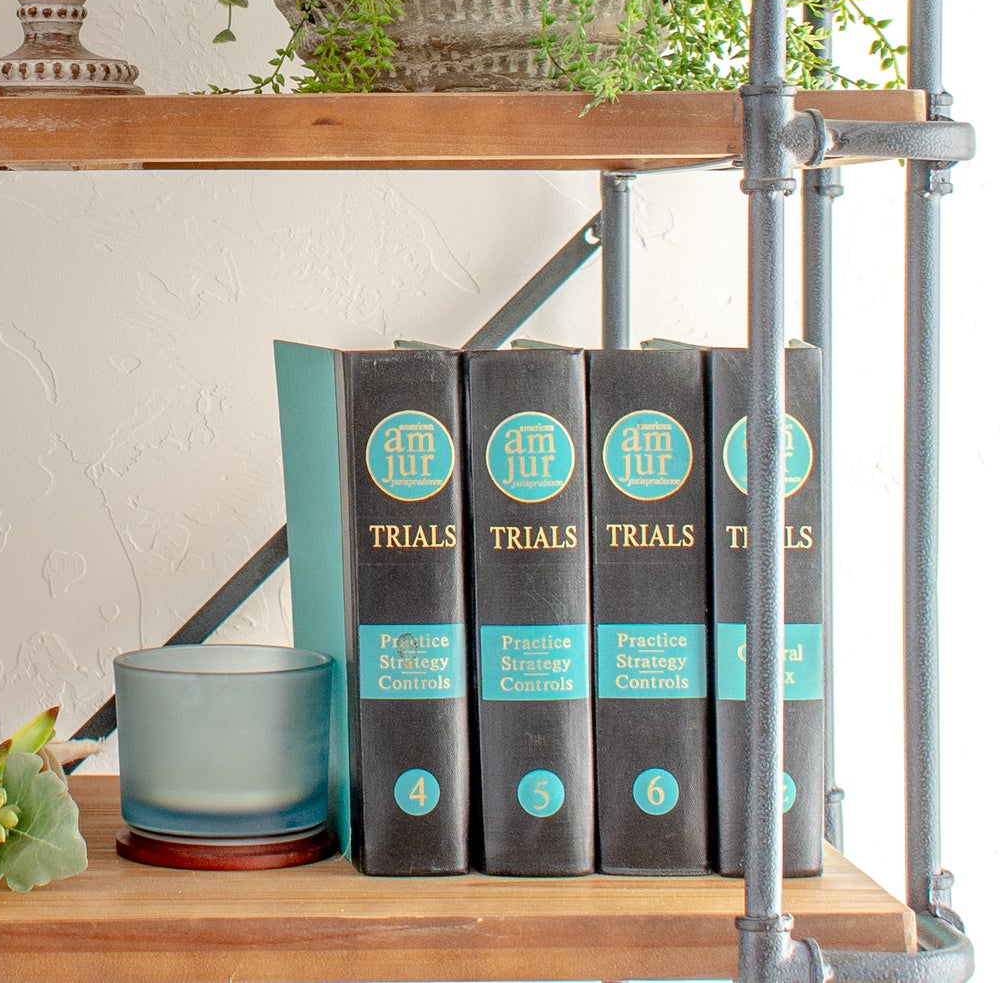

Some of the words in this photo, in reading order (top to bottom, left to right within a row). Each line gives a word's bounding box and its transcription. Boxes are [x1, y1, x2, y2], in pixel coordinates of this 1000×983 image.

[384, 428, 436, 453] am
[504, 429, 556, 453] am
[620, 426, 673, 452] am
[382, 453, 434, 483] jur
[502, 454, 555, 484] jur
[618, 452, 672, 481] jur
[370, 525, 457, 548] TRIALS
[490, 526, 578, 549] TRIALS
[606, 524, 695, 547] TRIALS
[726, 525, 813, 548] TLS
[380, 634, 449, 648] Practice
[502, 635, 571, 650] Practice
[617, 633, 688, 647] Practice
[380, 655, 449, 670] Strategy
[501, 656, 571, 672] Strategy
[616, 654, 687, 670] Strategy
[379, 676, 452, 690] Controls
[500, 677, 573, 691] Controls
[615, 675, 689, 689] Controls
[409, 776, 427, 807] 4
[533, 780, 550, 810] 5
[647, 776, 665, 806] 6
